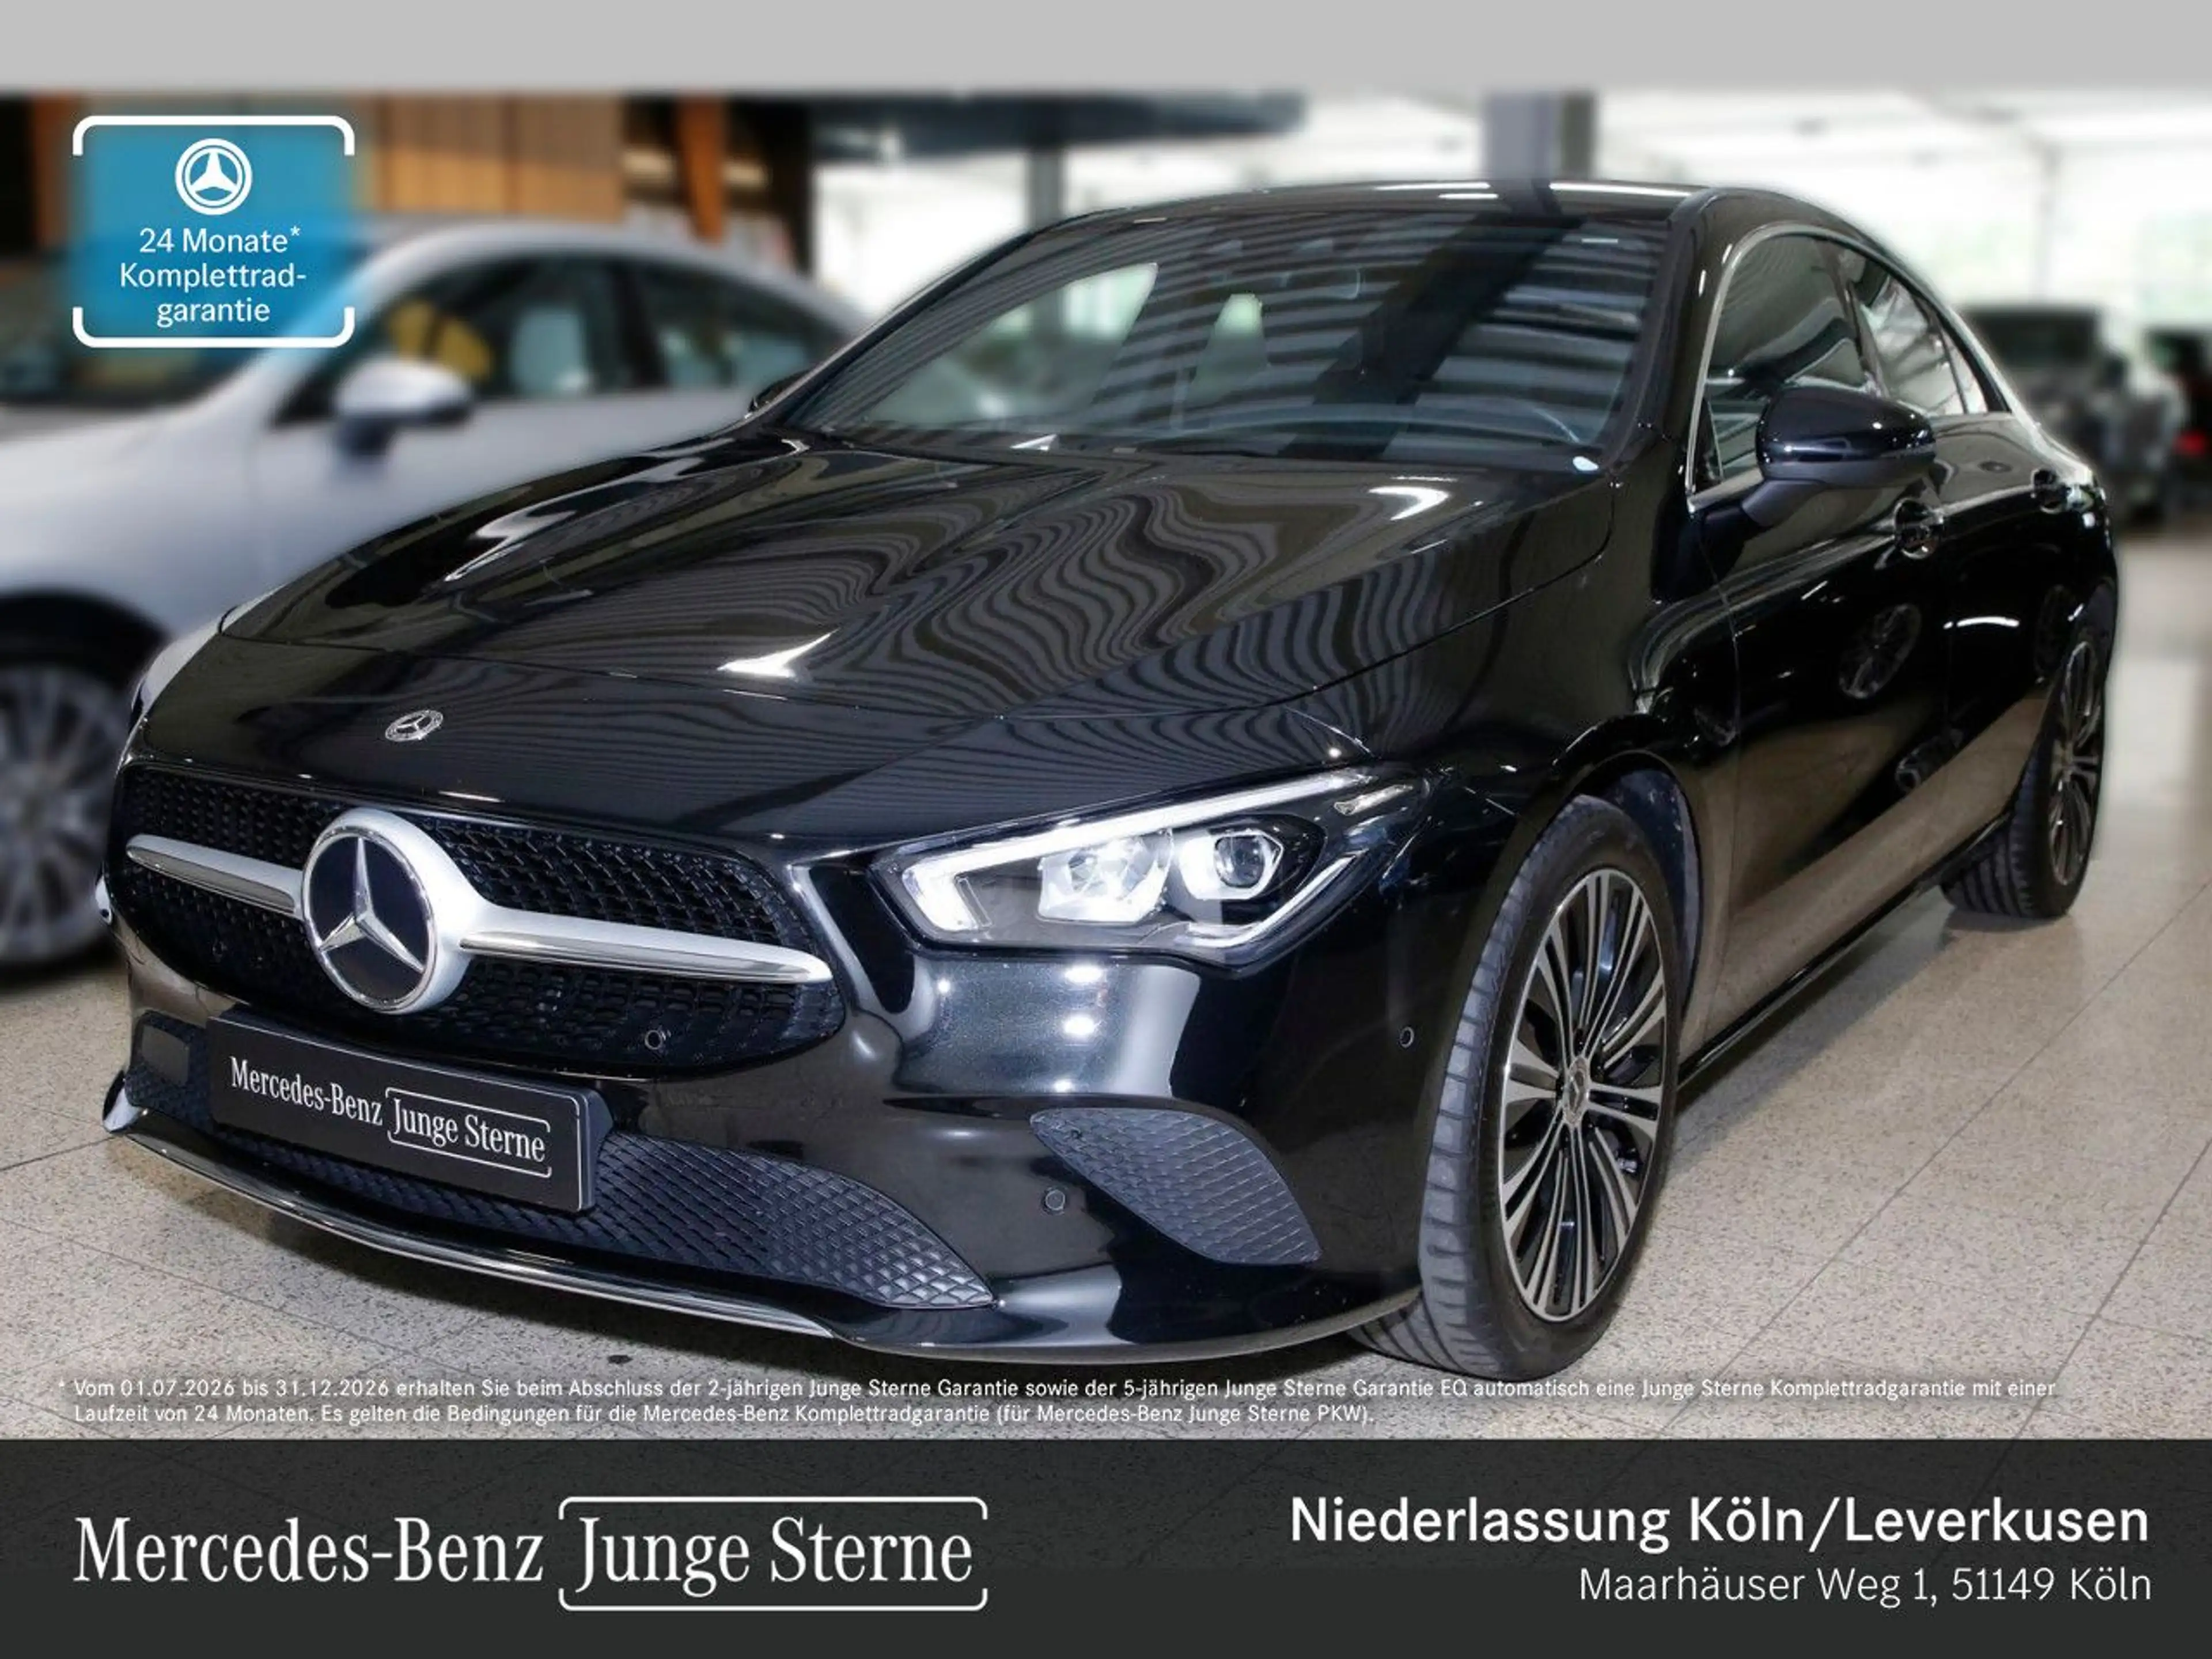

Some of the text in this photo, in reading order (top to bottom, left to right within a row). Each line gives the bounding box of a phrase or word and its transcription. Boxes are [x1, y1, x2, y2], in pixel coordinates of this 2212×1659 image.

[230, 1056, 545, 1162] Mercedes-Benz Junge Sterne
